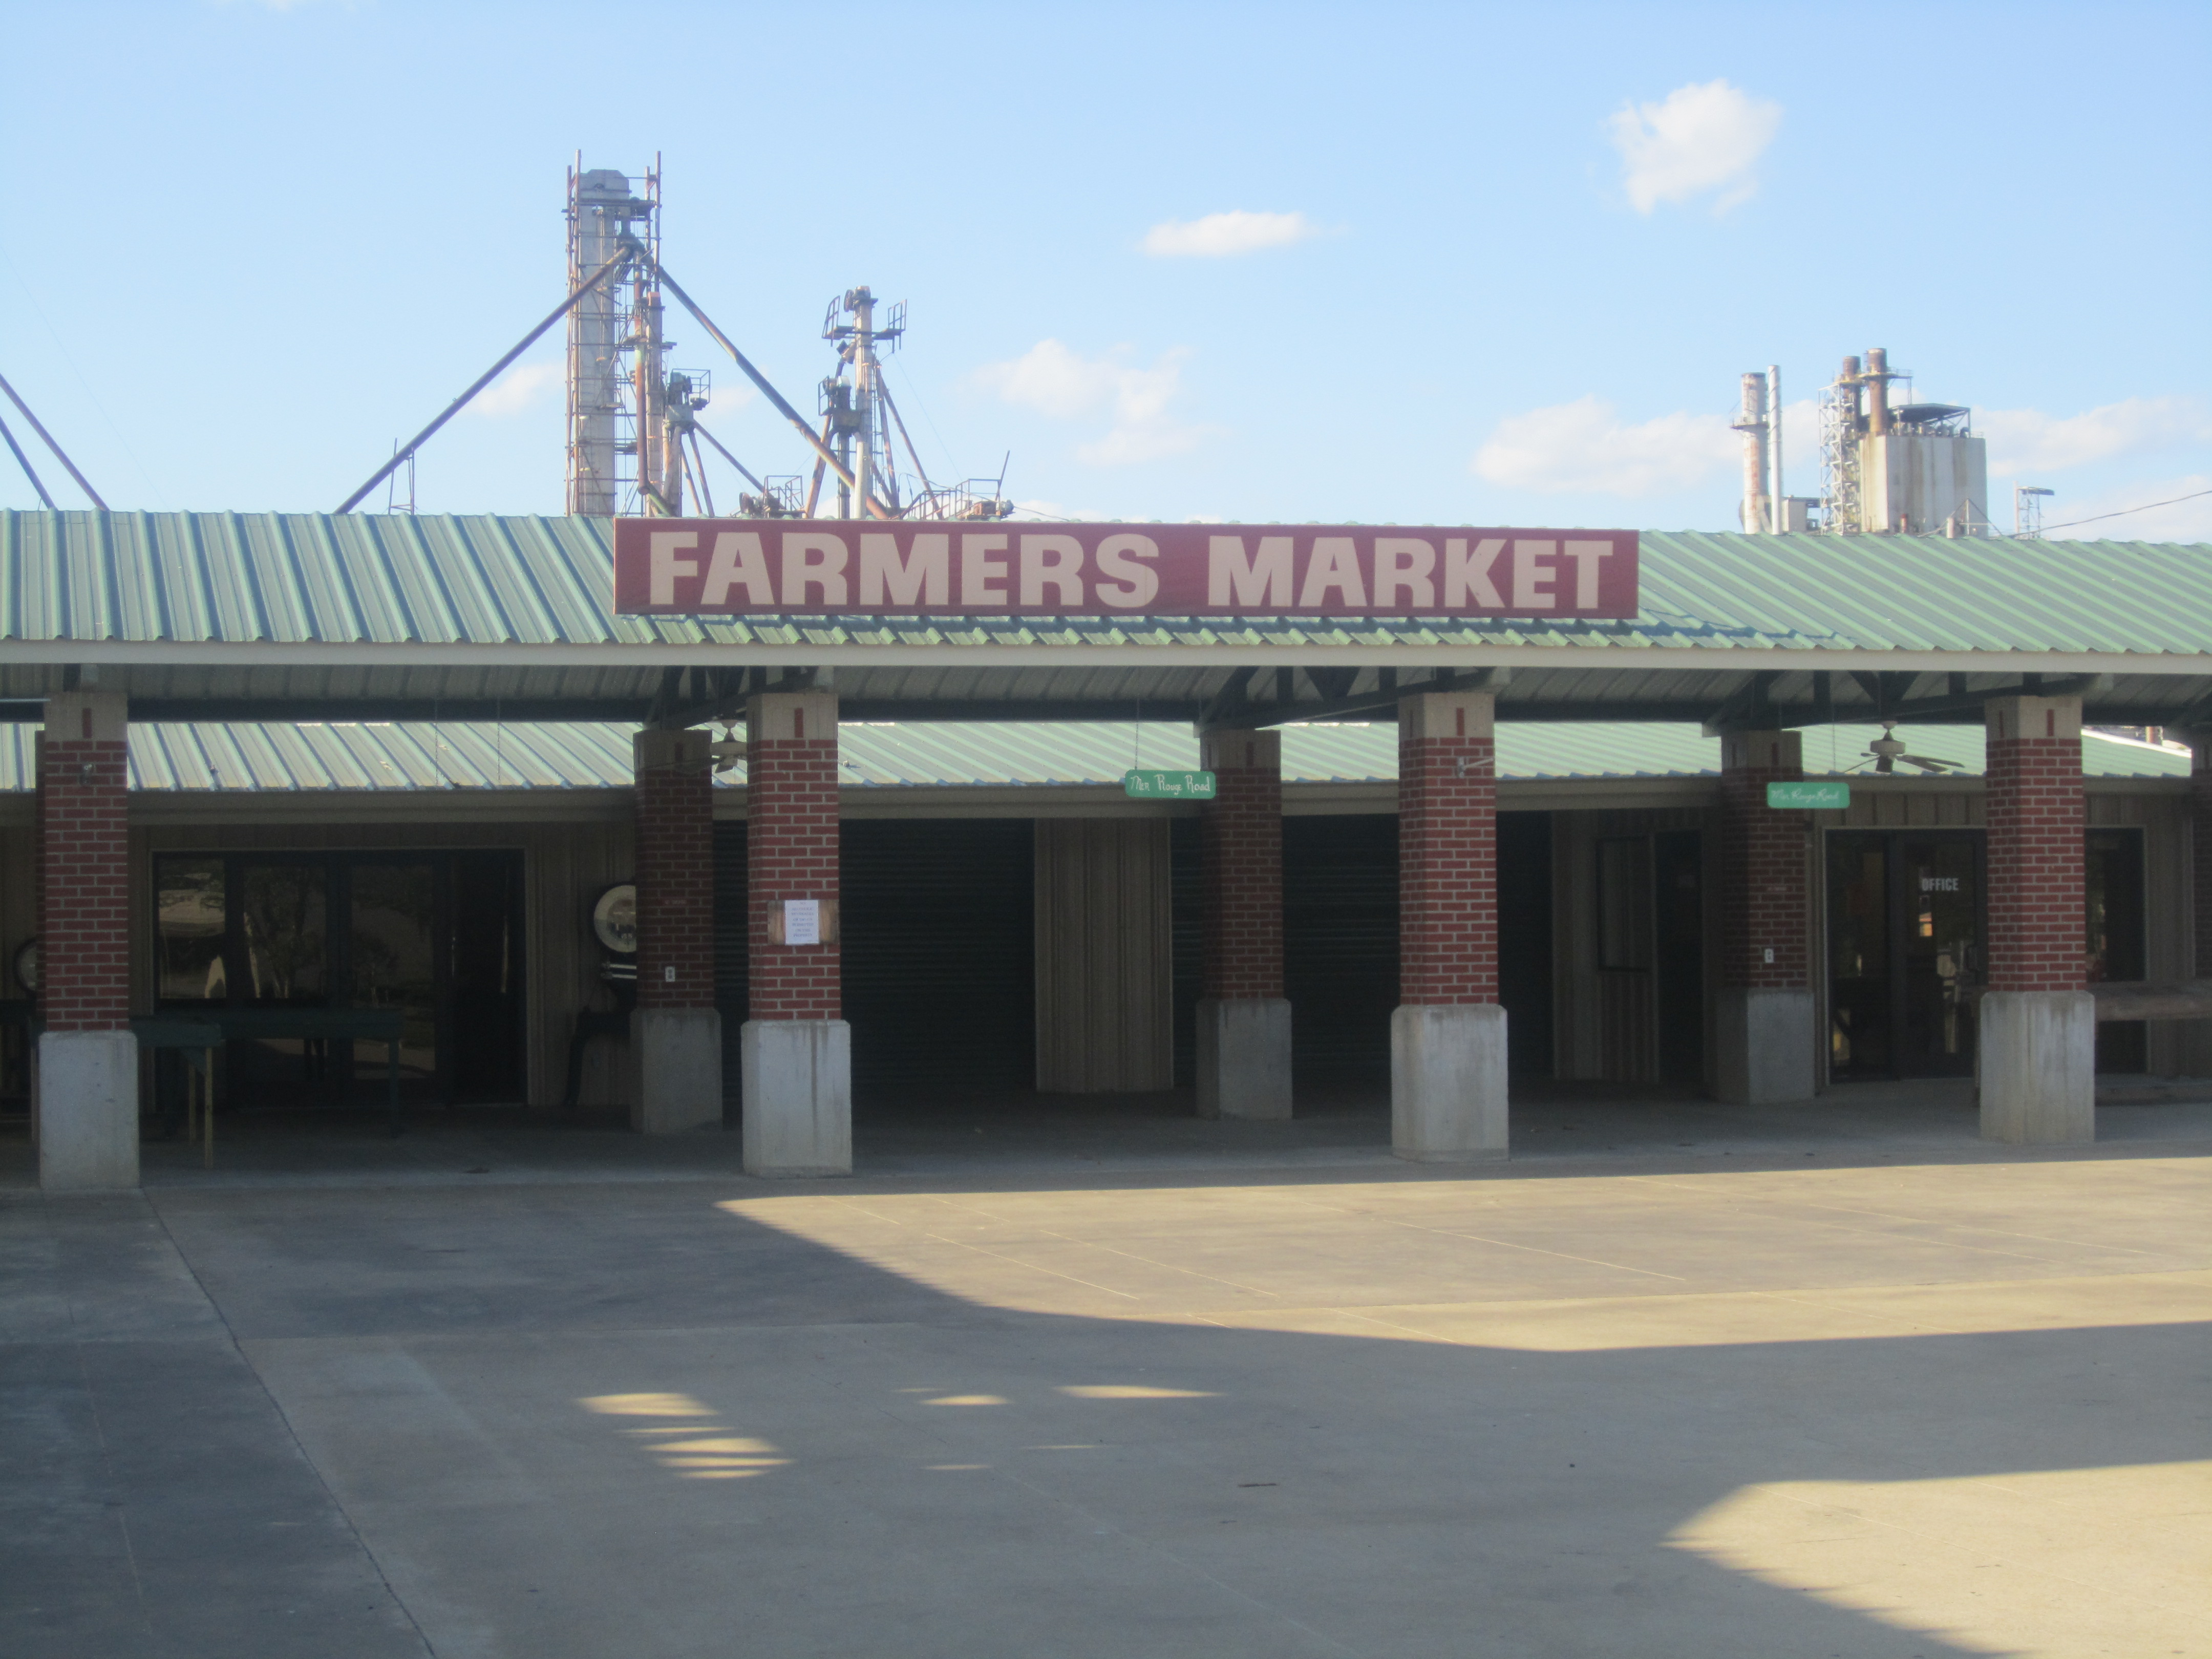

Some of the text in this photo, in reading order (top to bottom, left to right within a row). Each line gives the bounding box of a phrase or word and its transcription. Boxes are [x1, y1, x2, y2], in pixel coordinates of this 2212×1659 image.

[650, 531, 1613, 609] FARMERS MARKET
[1184, 774, 1210, 793] Road
[1922, 878, 1959, 891] OFFICE
